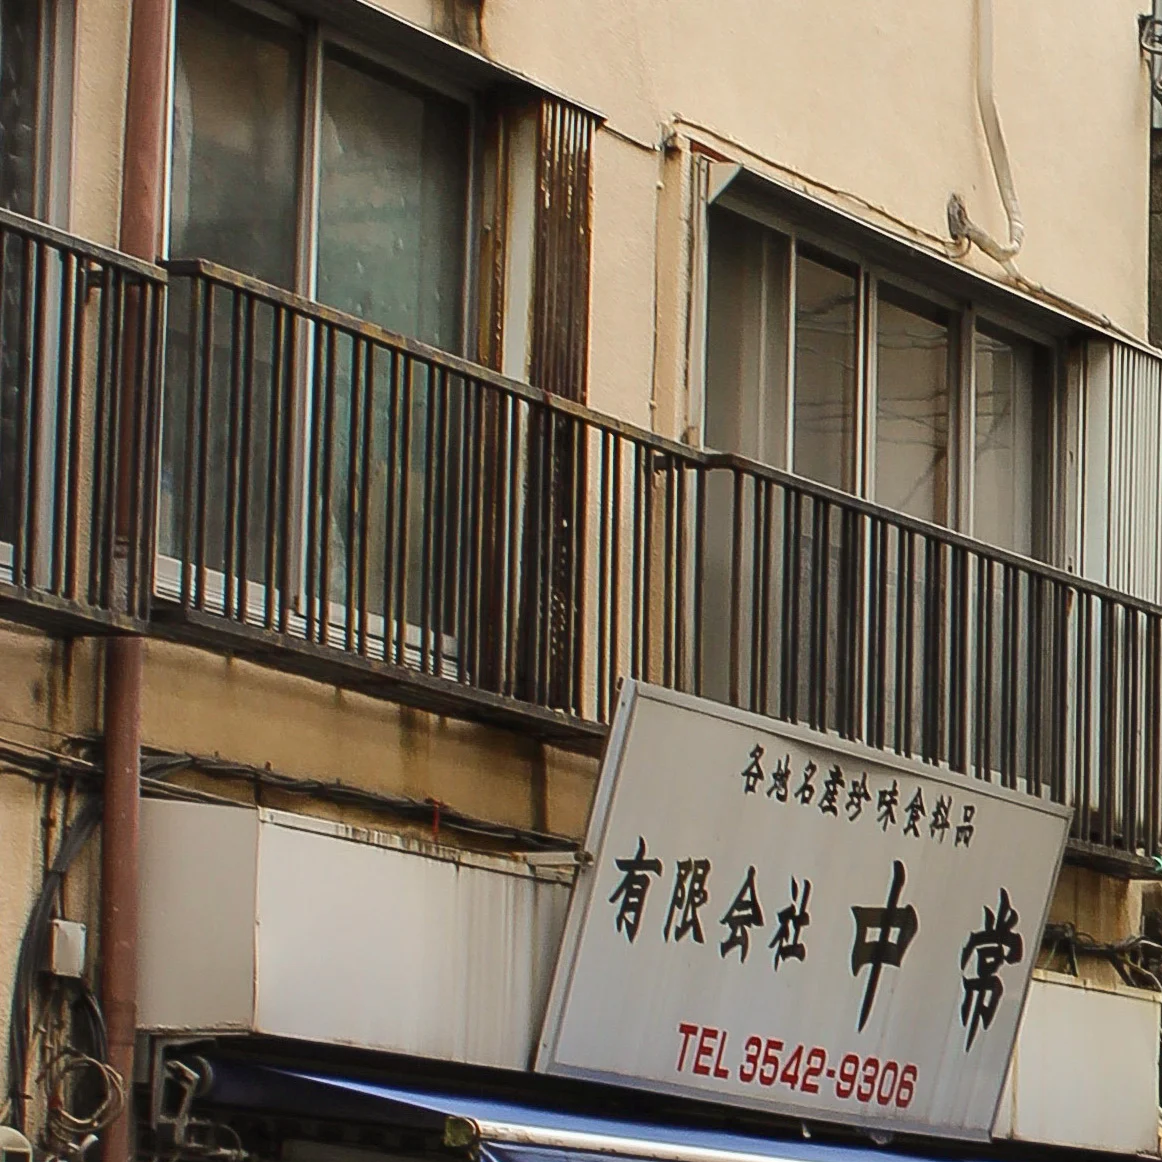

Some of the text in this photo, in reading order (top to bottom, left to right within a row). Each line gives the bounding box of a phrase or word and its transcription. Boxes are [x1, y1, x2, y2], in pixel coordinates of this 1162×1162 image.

[740, 743, 977, 848] 各地名産珍味食料品
[676, 1022, 918, 1109] TEL 3542-9306
